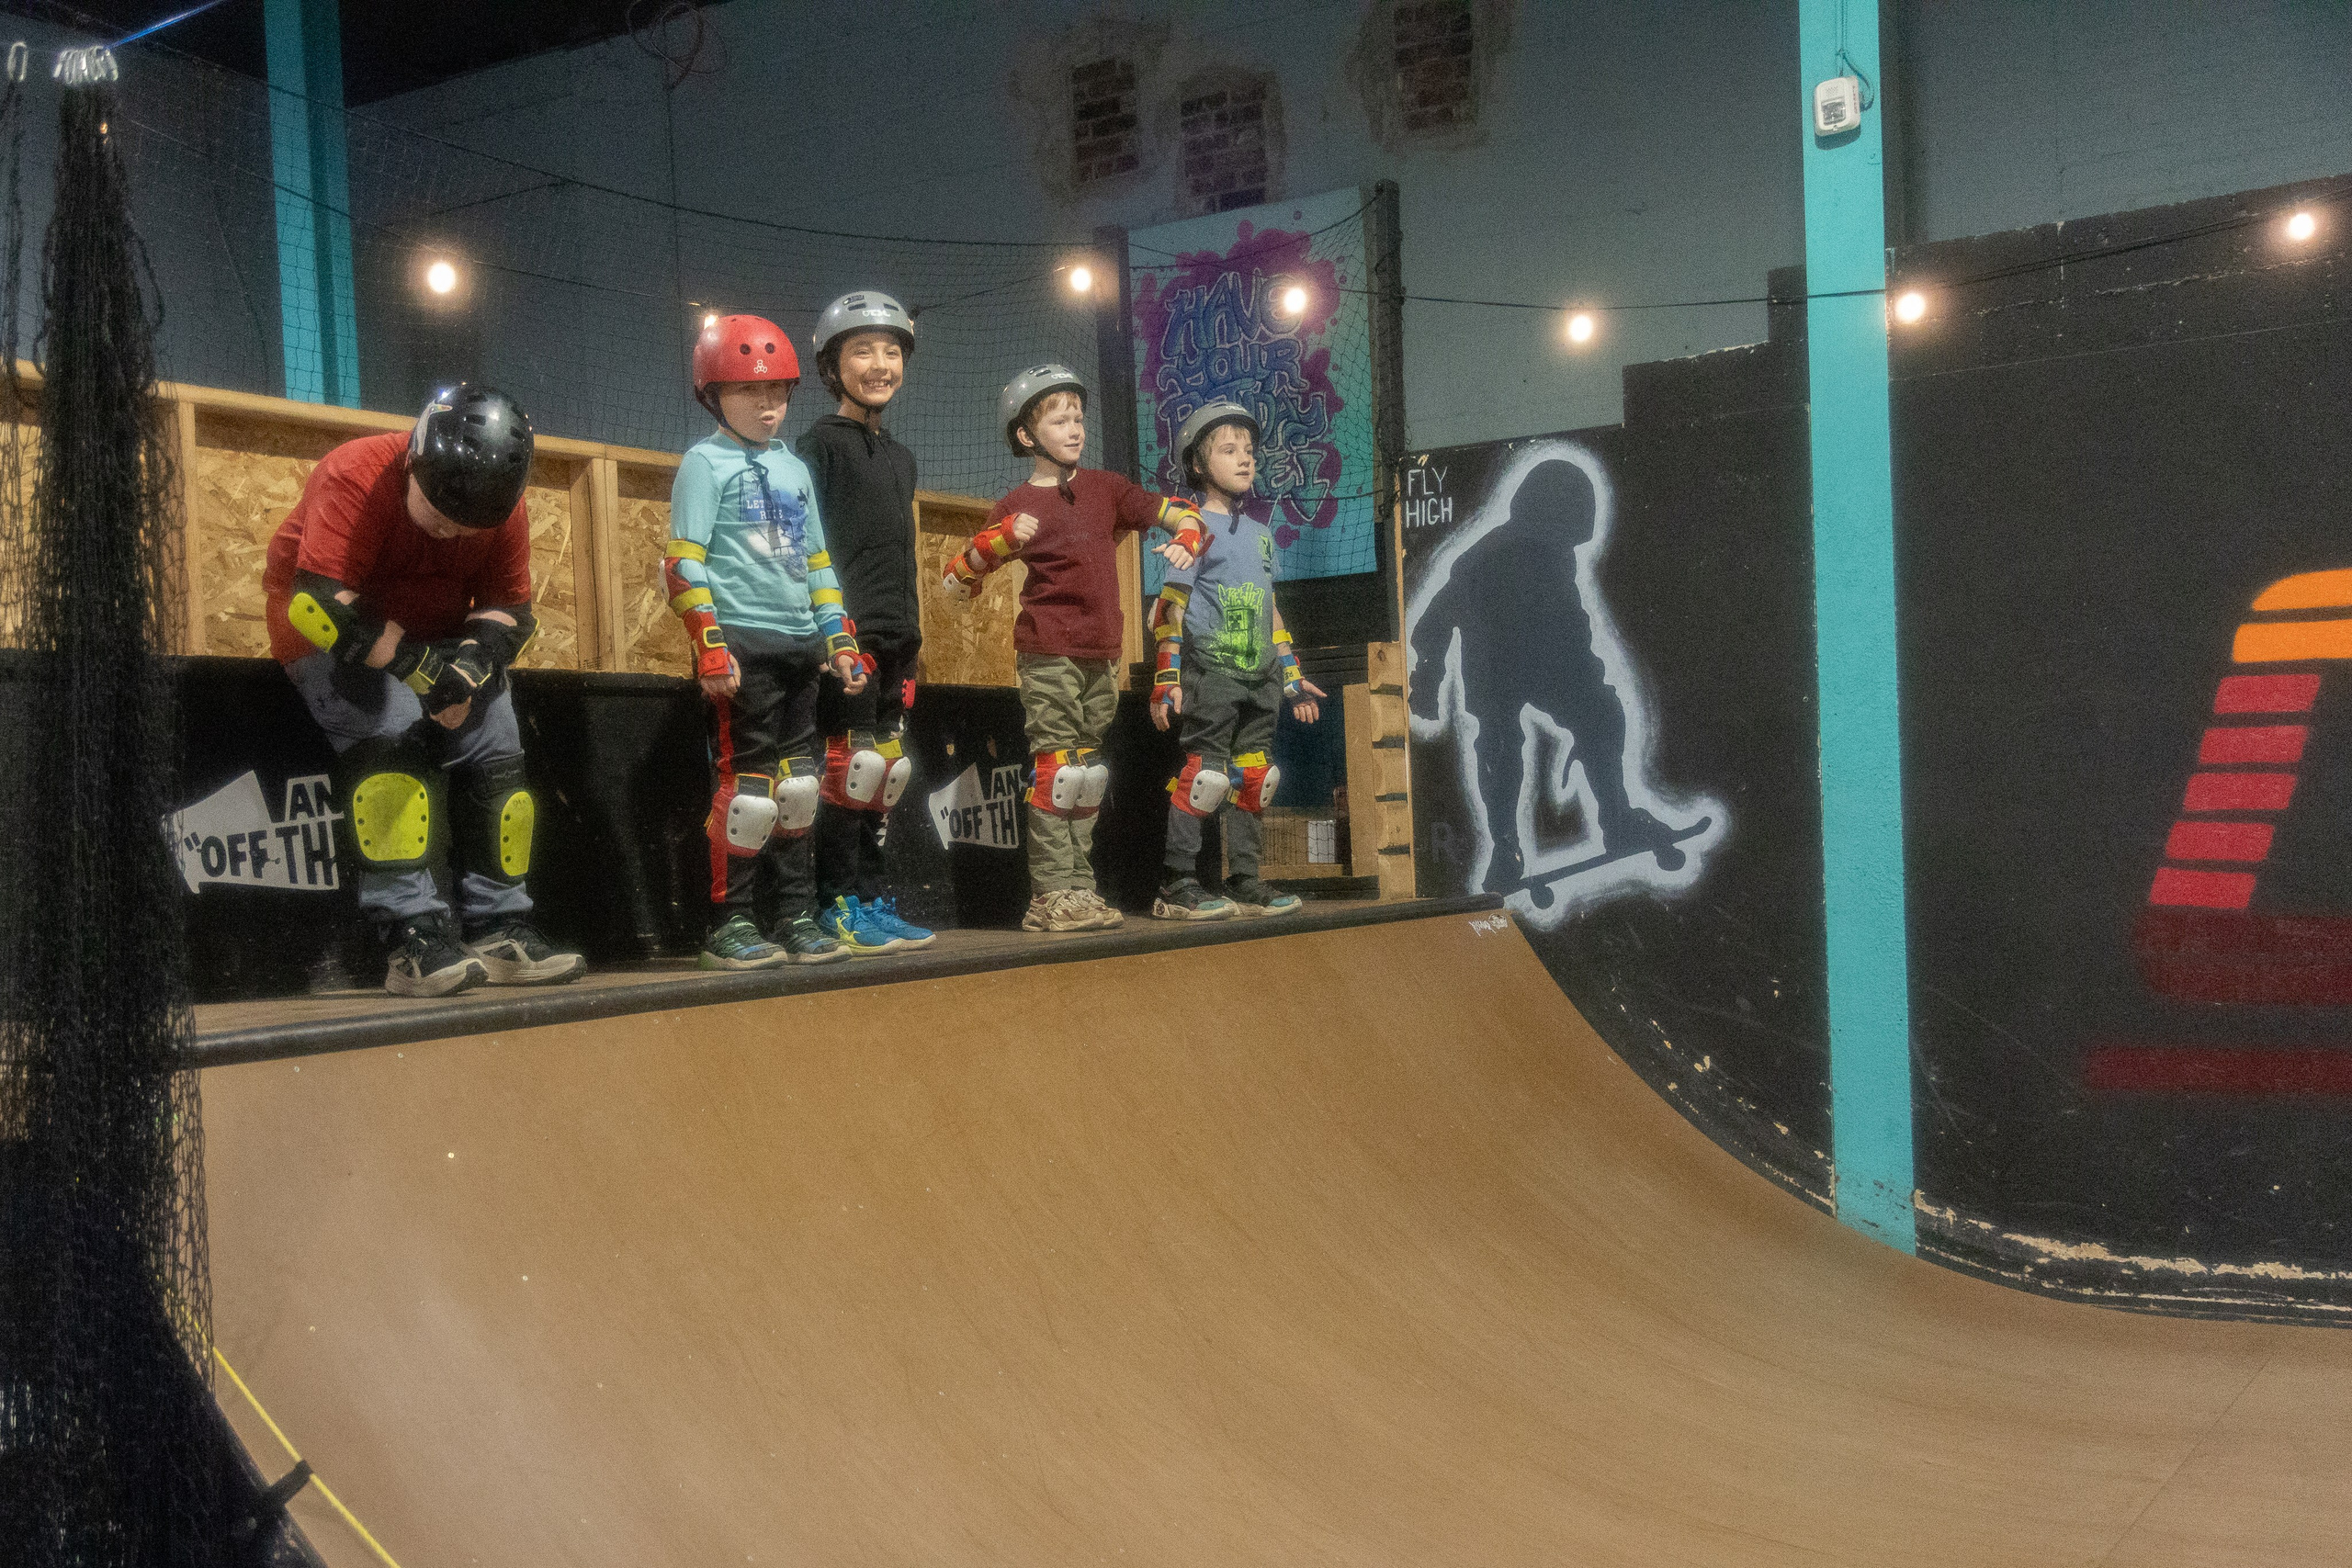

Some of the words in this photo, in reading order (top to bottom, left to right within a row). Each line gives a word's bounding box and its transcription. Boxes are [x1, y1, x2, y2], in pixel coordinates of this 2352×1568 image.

[1161, 267, 1304, 360] HAVE
[1157, 338, 1310, 396] YOUR
[1408, 466, 1448, 496] FLY
[1406, 496, 1453, 528] HIGH
